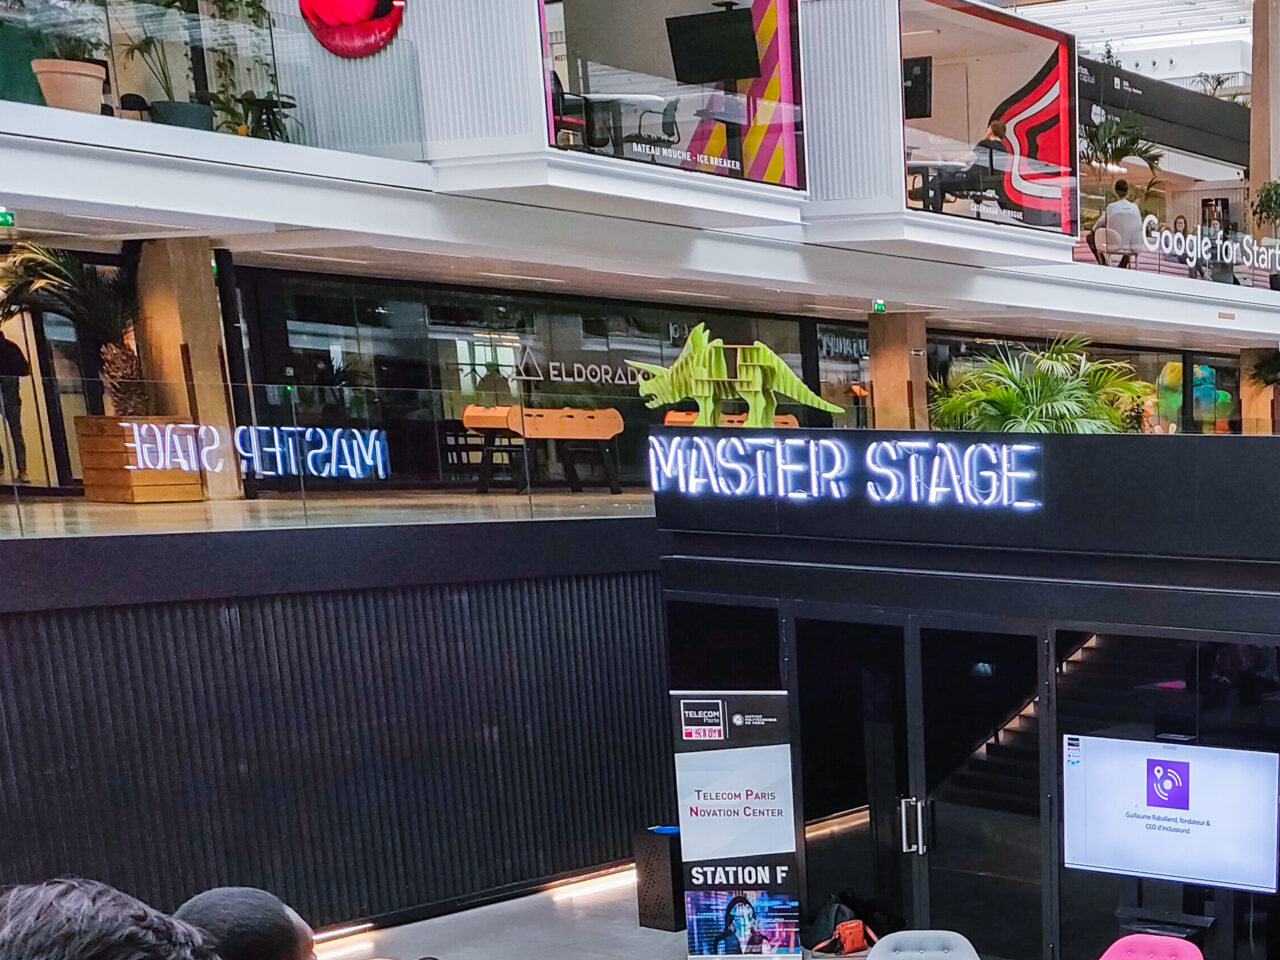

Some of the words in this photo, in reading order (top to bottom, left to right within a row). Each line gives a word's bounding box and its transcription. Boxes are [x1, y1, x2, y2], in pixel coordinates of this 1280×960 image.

[632, 141, 660, 154] BATEAU
[661, 147, 691, 161] MOUCHE
[697, 153, 709, 165] ICE
[709, 155, 741, 171] BREAKER
[1142, 214, 1212, 268] Google
[1215, 231, 1241, 264] for
[648, 435, 845, 499] MASTER
[866, 440, 1043, 509] STAGE
[684, 710, 720, 718] TELECOM
[694, 789, 742, 801] TELECOM
[745, 789, 776, 801] PARIS
[689, 806, 740, 818] NOVATION
[743, 806, 784, 818] CENTER
[691, 865, 770, 885] STATION
[776, 865, 789, 884] F
